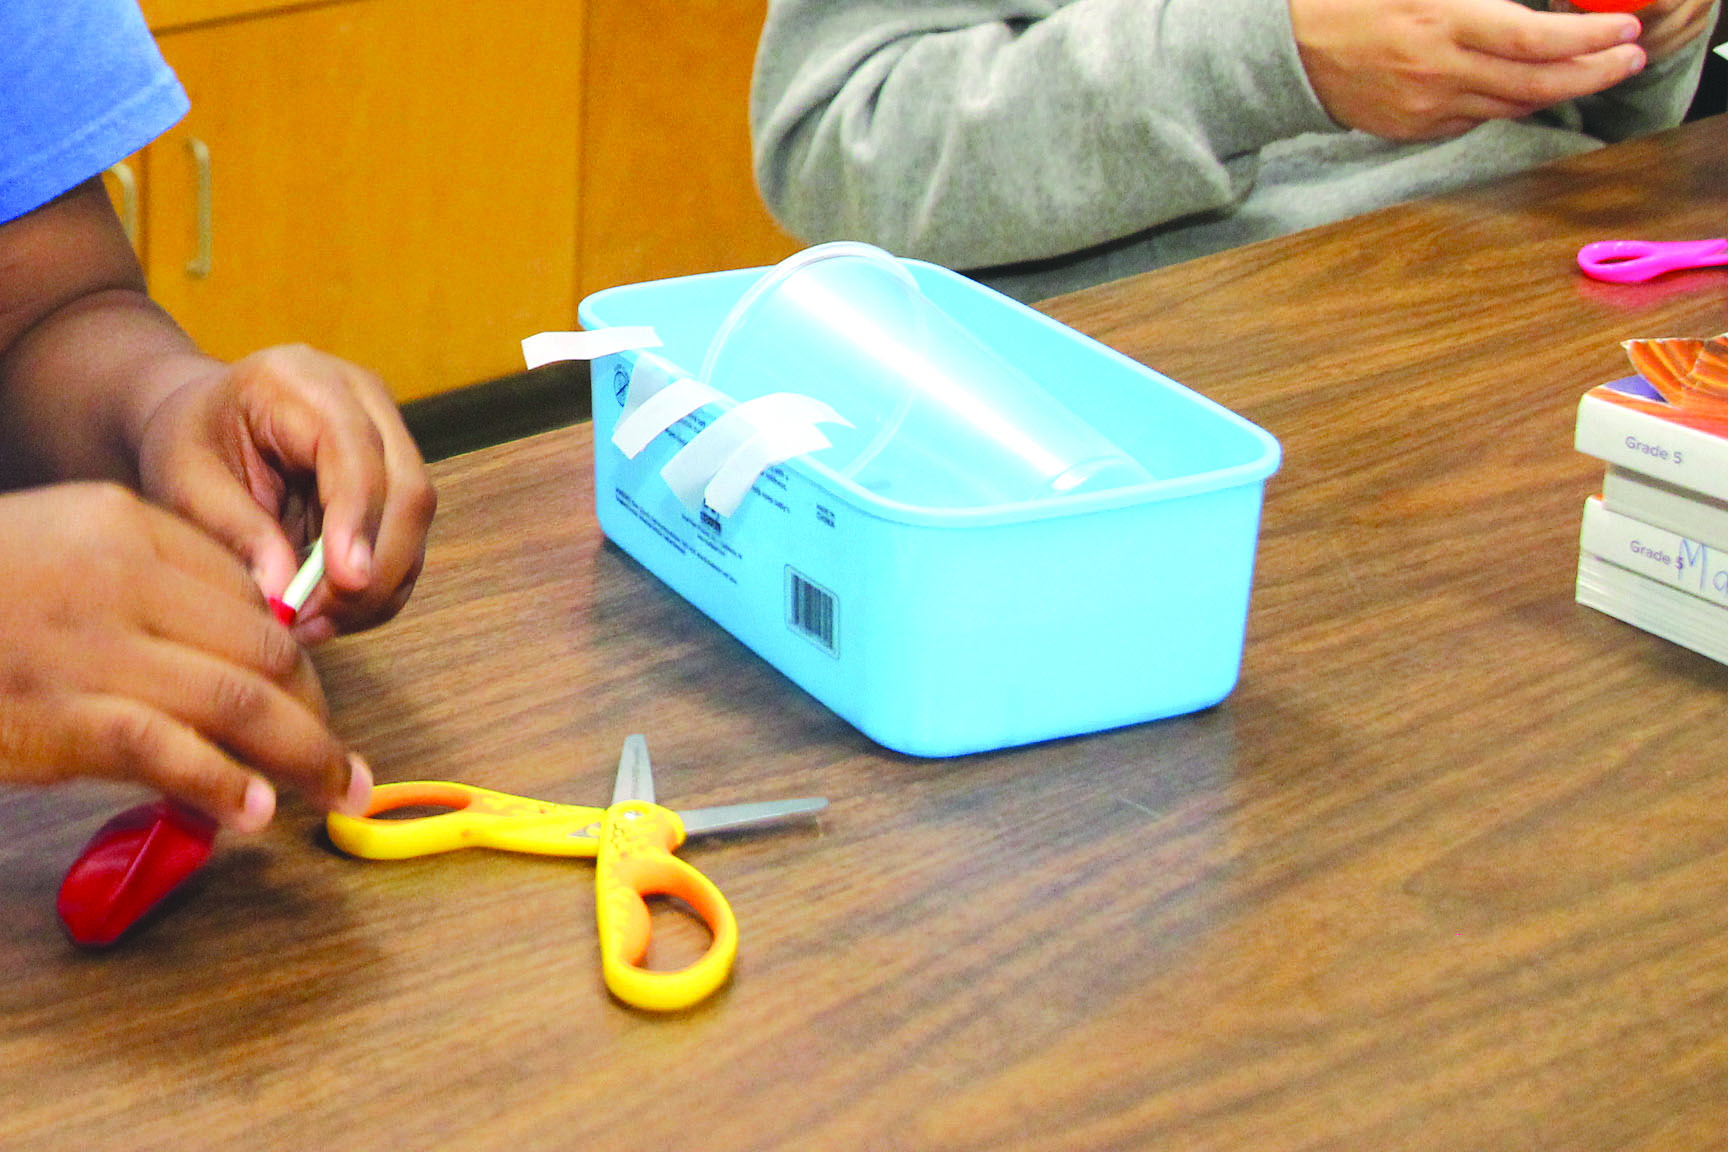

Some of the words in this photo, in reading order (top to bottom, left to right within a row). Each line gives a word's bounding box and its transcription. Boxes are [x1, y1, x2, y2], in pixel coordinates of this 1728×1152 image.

[1625, 435, 1668, 460] Grade
[1673, 451, 1683, 464] 5
[1630, 539, 1671, 566] Grade
